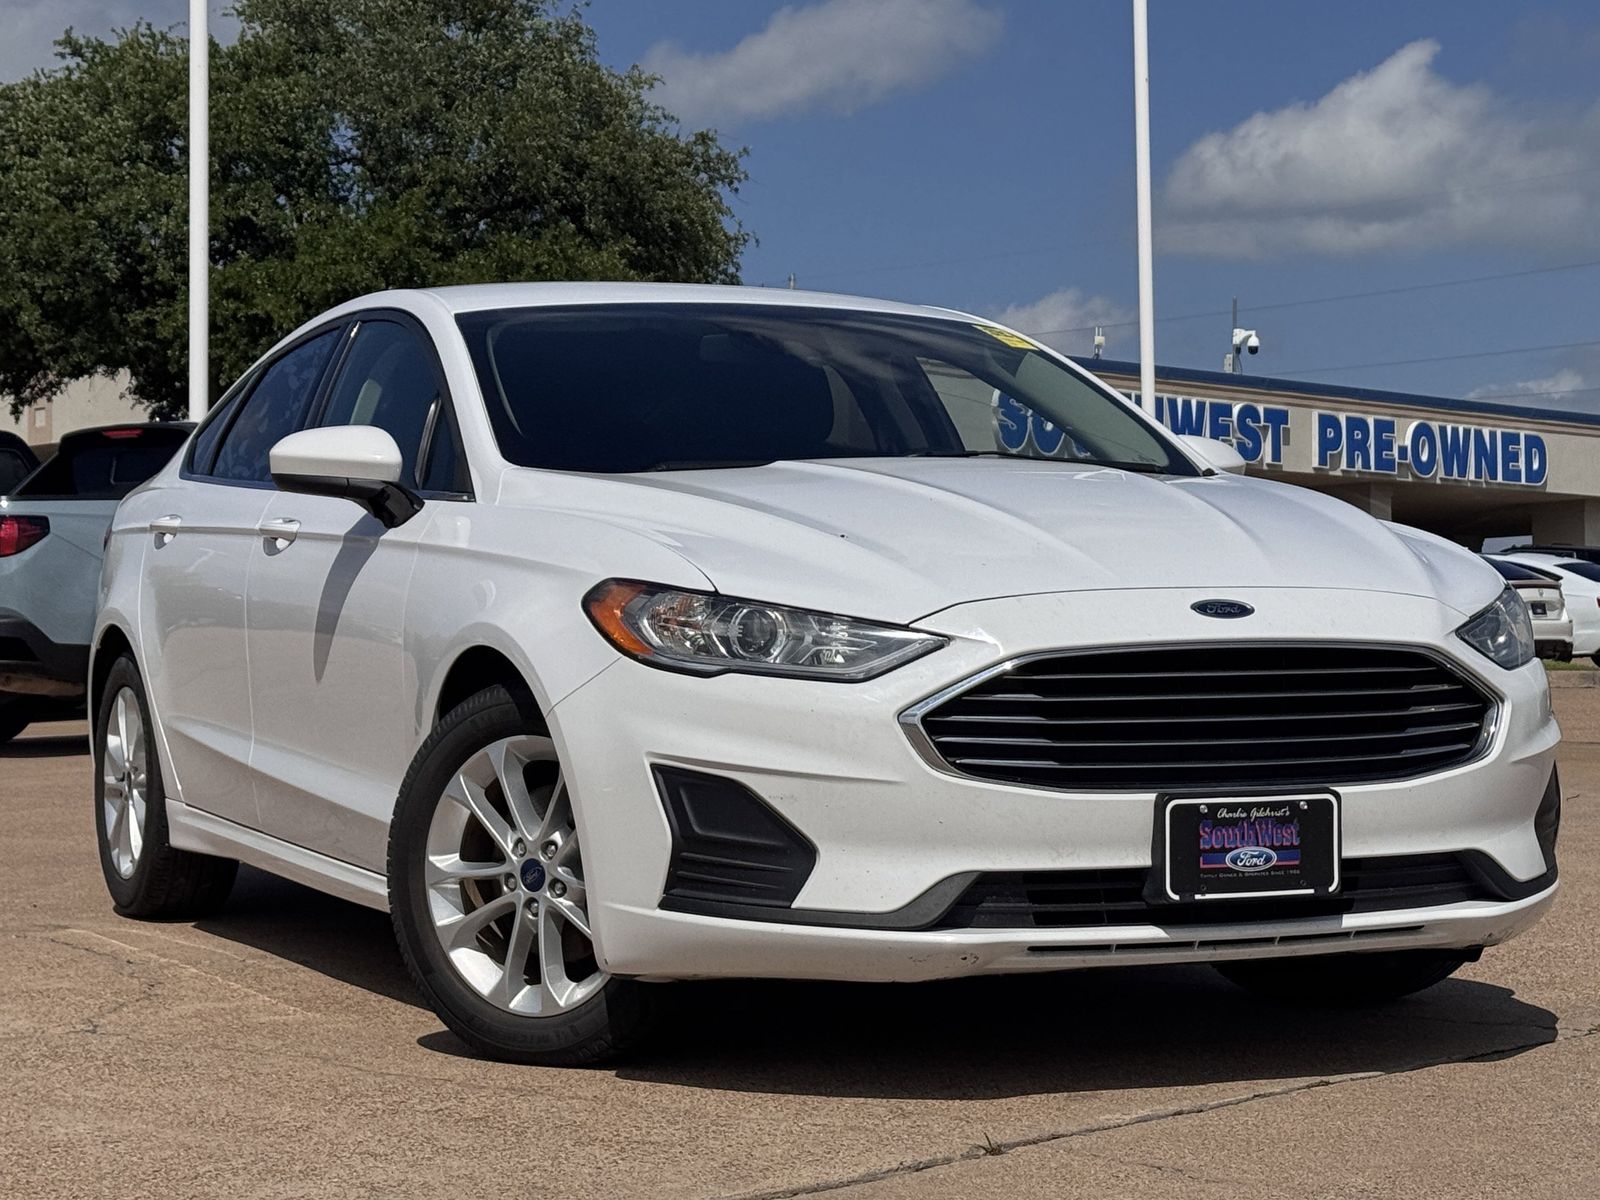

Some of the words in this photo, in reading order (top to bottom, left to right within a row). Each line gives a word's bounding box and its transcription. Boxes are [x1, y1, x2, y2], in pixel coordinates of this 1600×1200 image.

[1313, 411, 1547, 485] PRE-OWNED
[1217, 808, 1247, 818] Charlie
[1237, 850, 1266, 866] Ford
